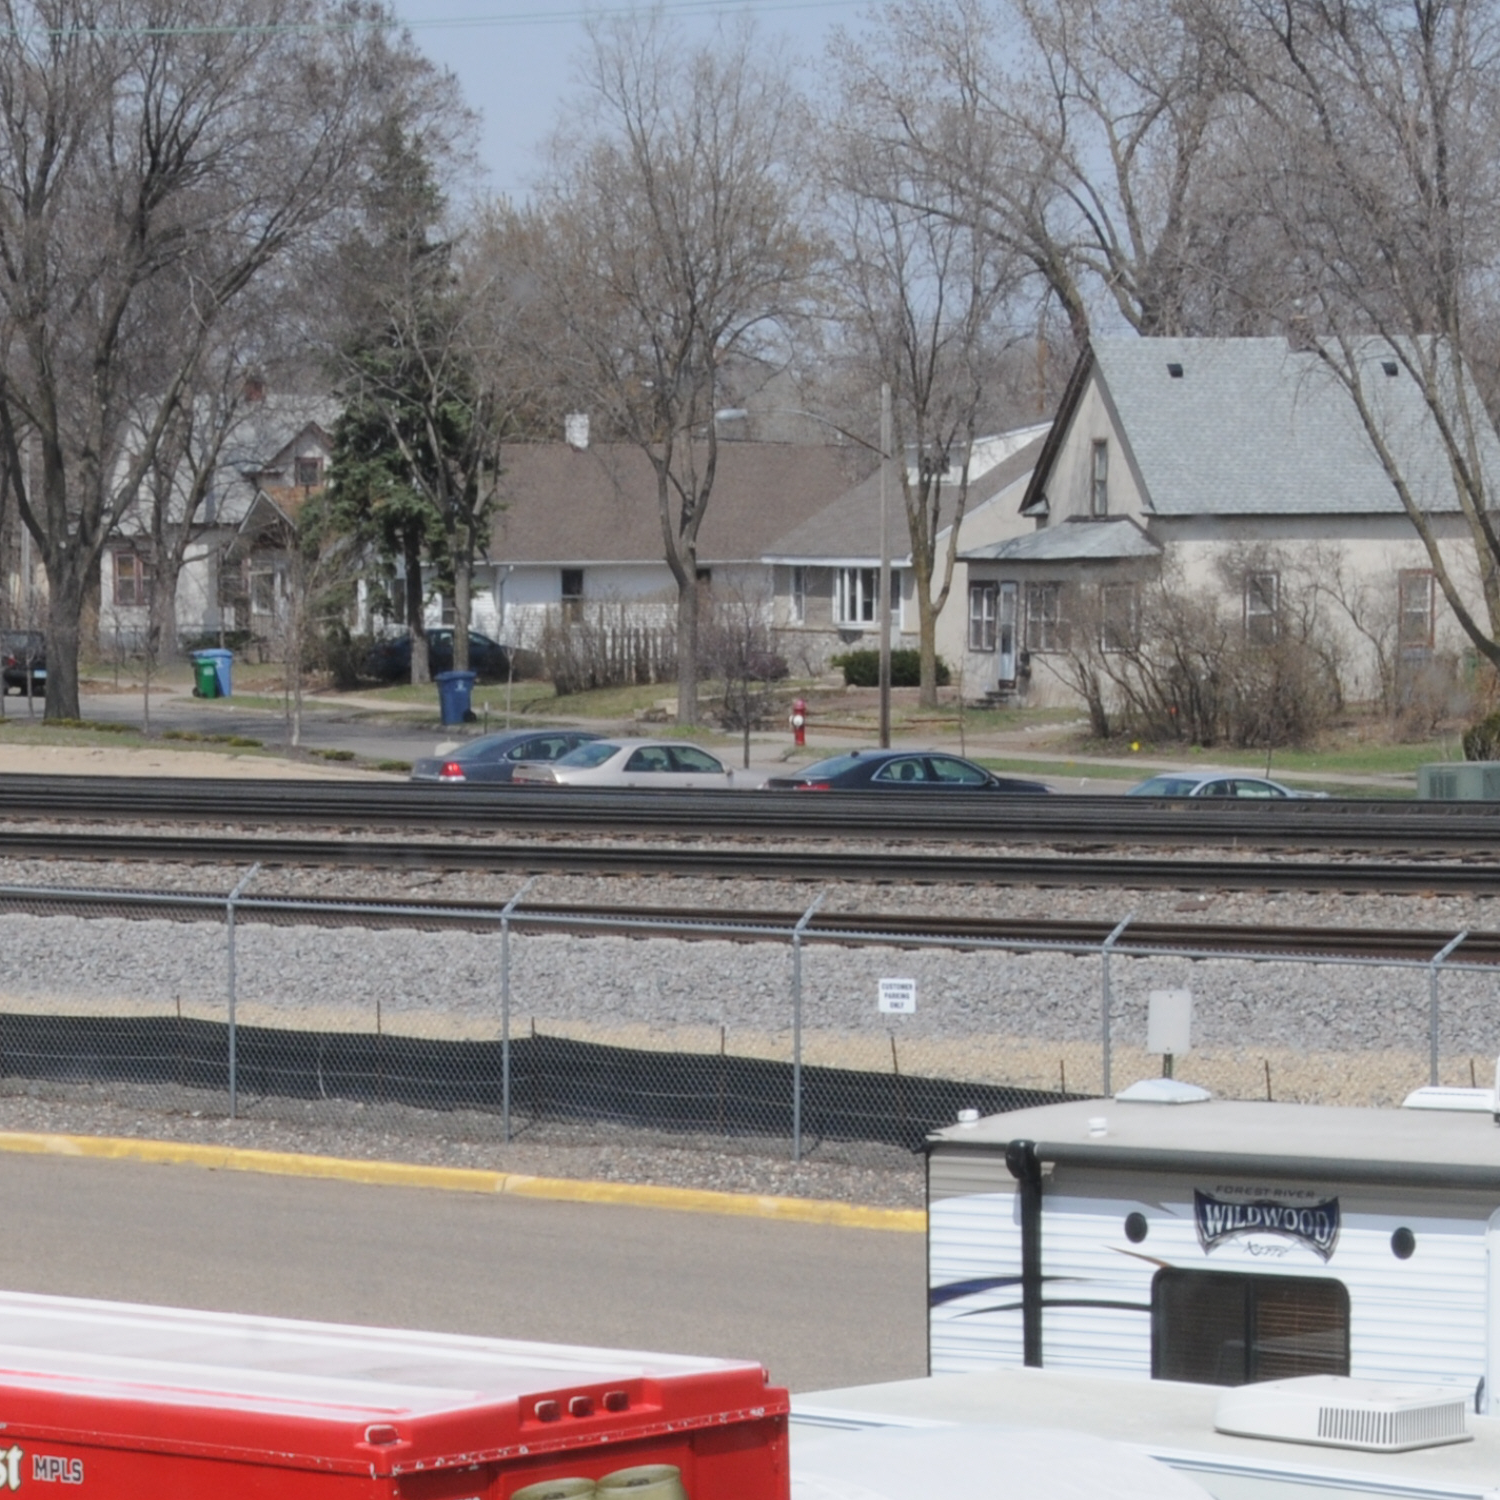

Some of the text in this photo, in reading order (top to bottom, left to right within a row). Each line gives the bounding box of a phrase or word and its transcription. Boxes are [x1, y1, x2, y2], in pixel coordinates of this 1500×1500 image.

[1215, 1184, 1316, 1199] FOREST RIVER
[1205, 1203, 1330, 1244] WILDWOOD
[32, 1453, 84, 1485] MPLS
